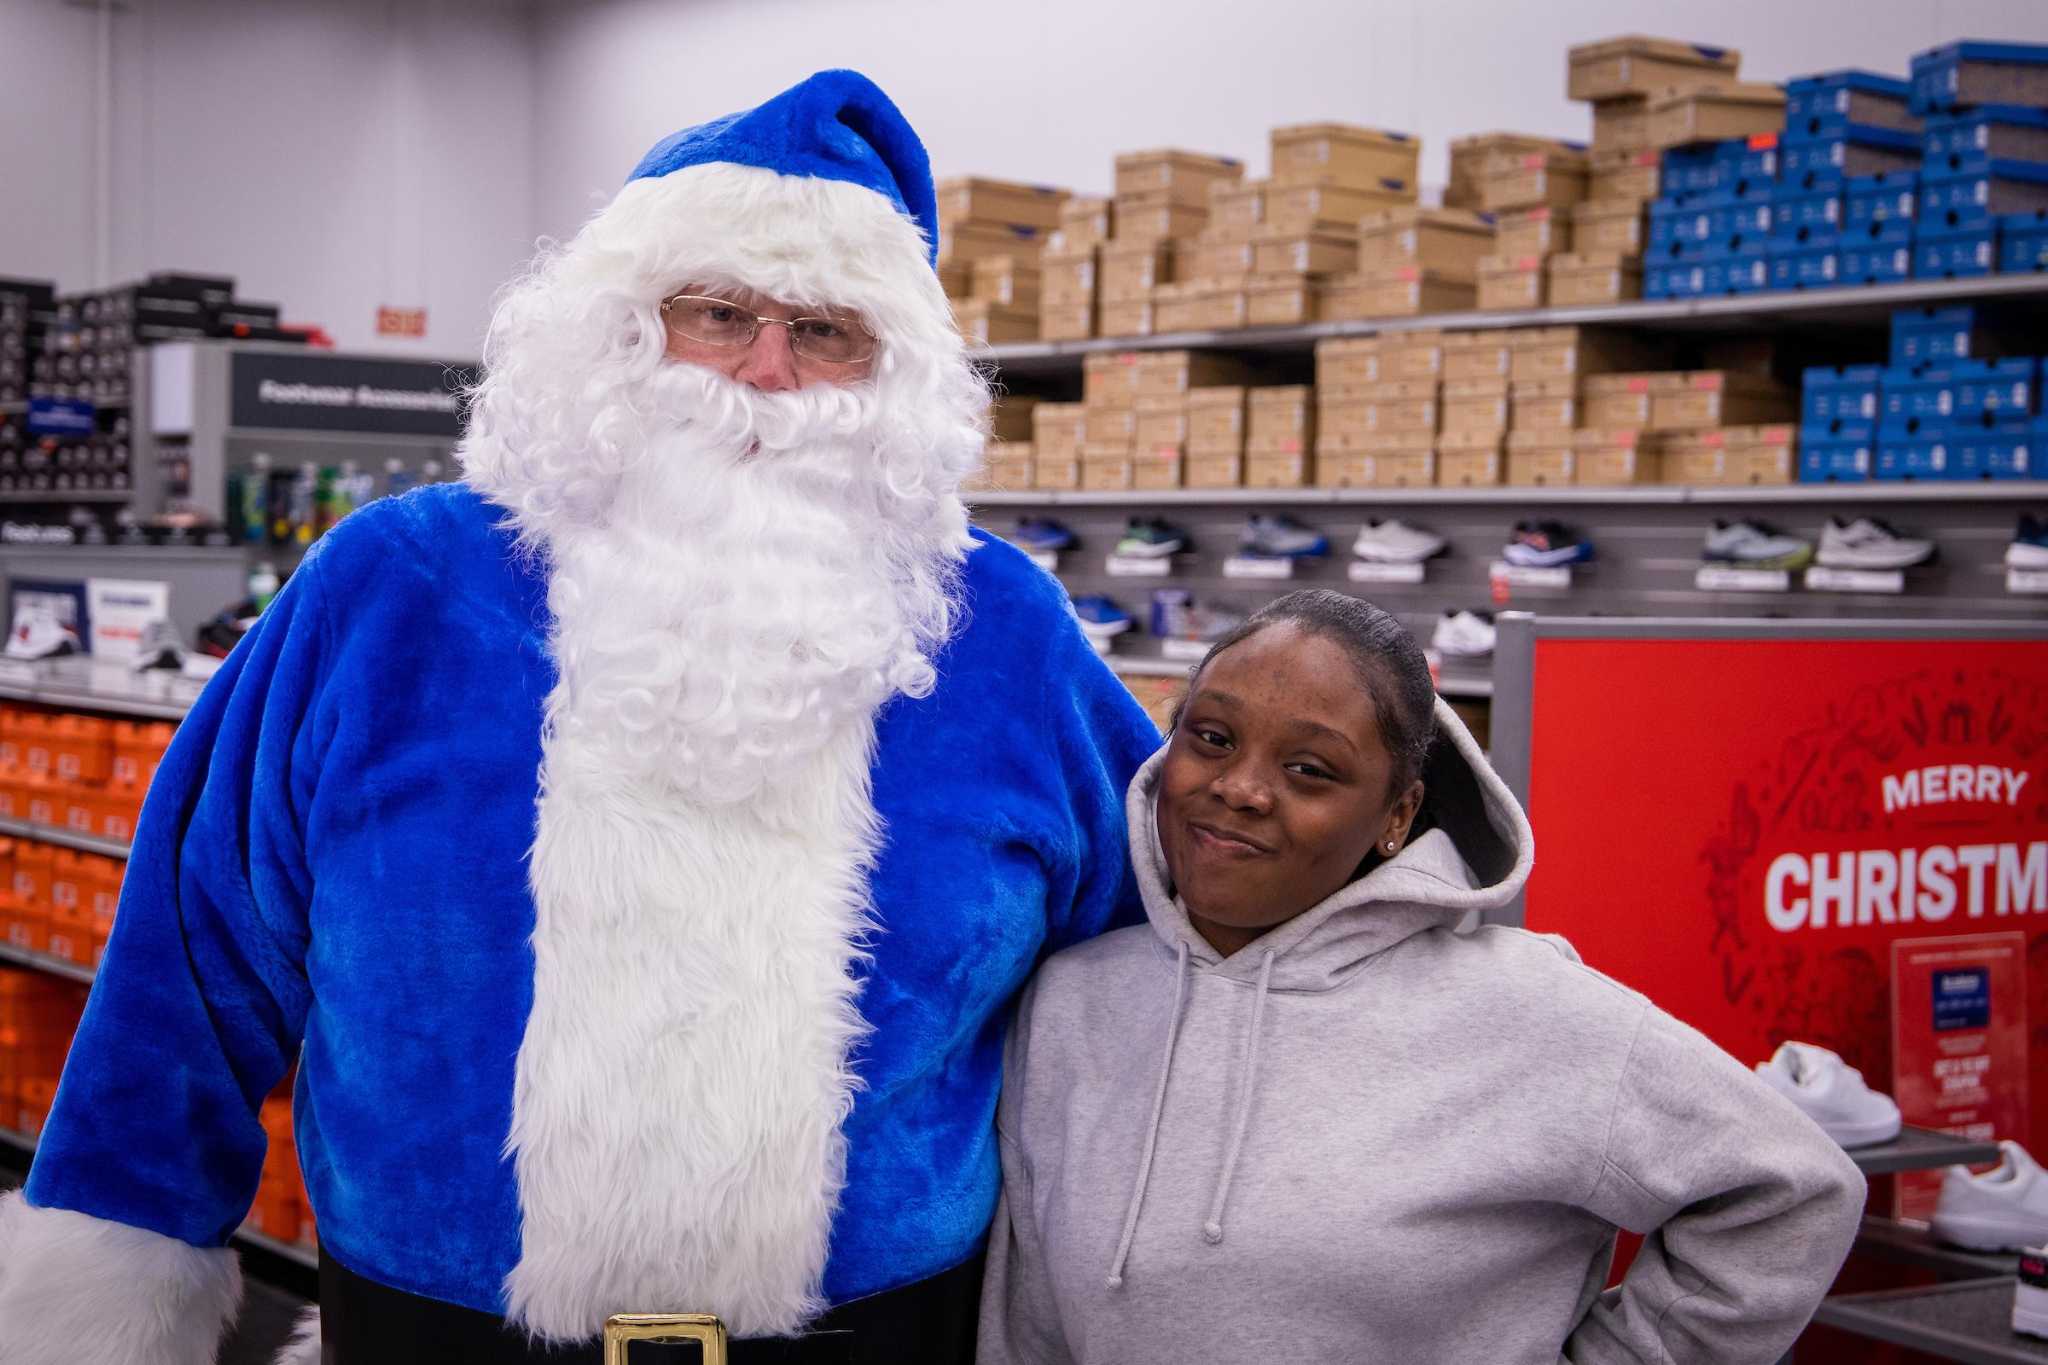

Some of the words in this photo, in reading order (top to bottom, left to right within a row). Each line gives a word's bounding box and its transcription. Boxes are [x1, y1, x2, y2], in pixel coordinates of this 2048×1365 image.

[259, 379, 353, 406] Footwear
[1882, 764, 2029, 813] MERRY
[1764, 840, 2048, 933] CHRISTM
